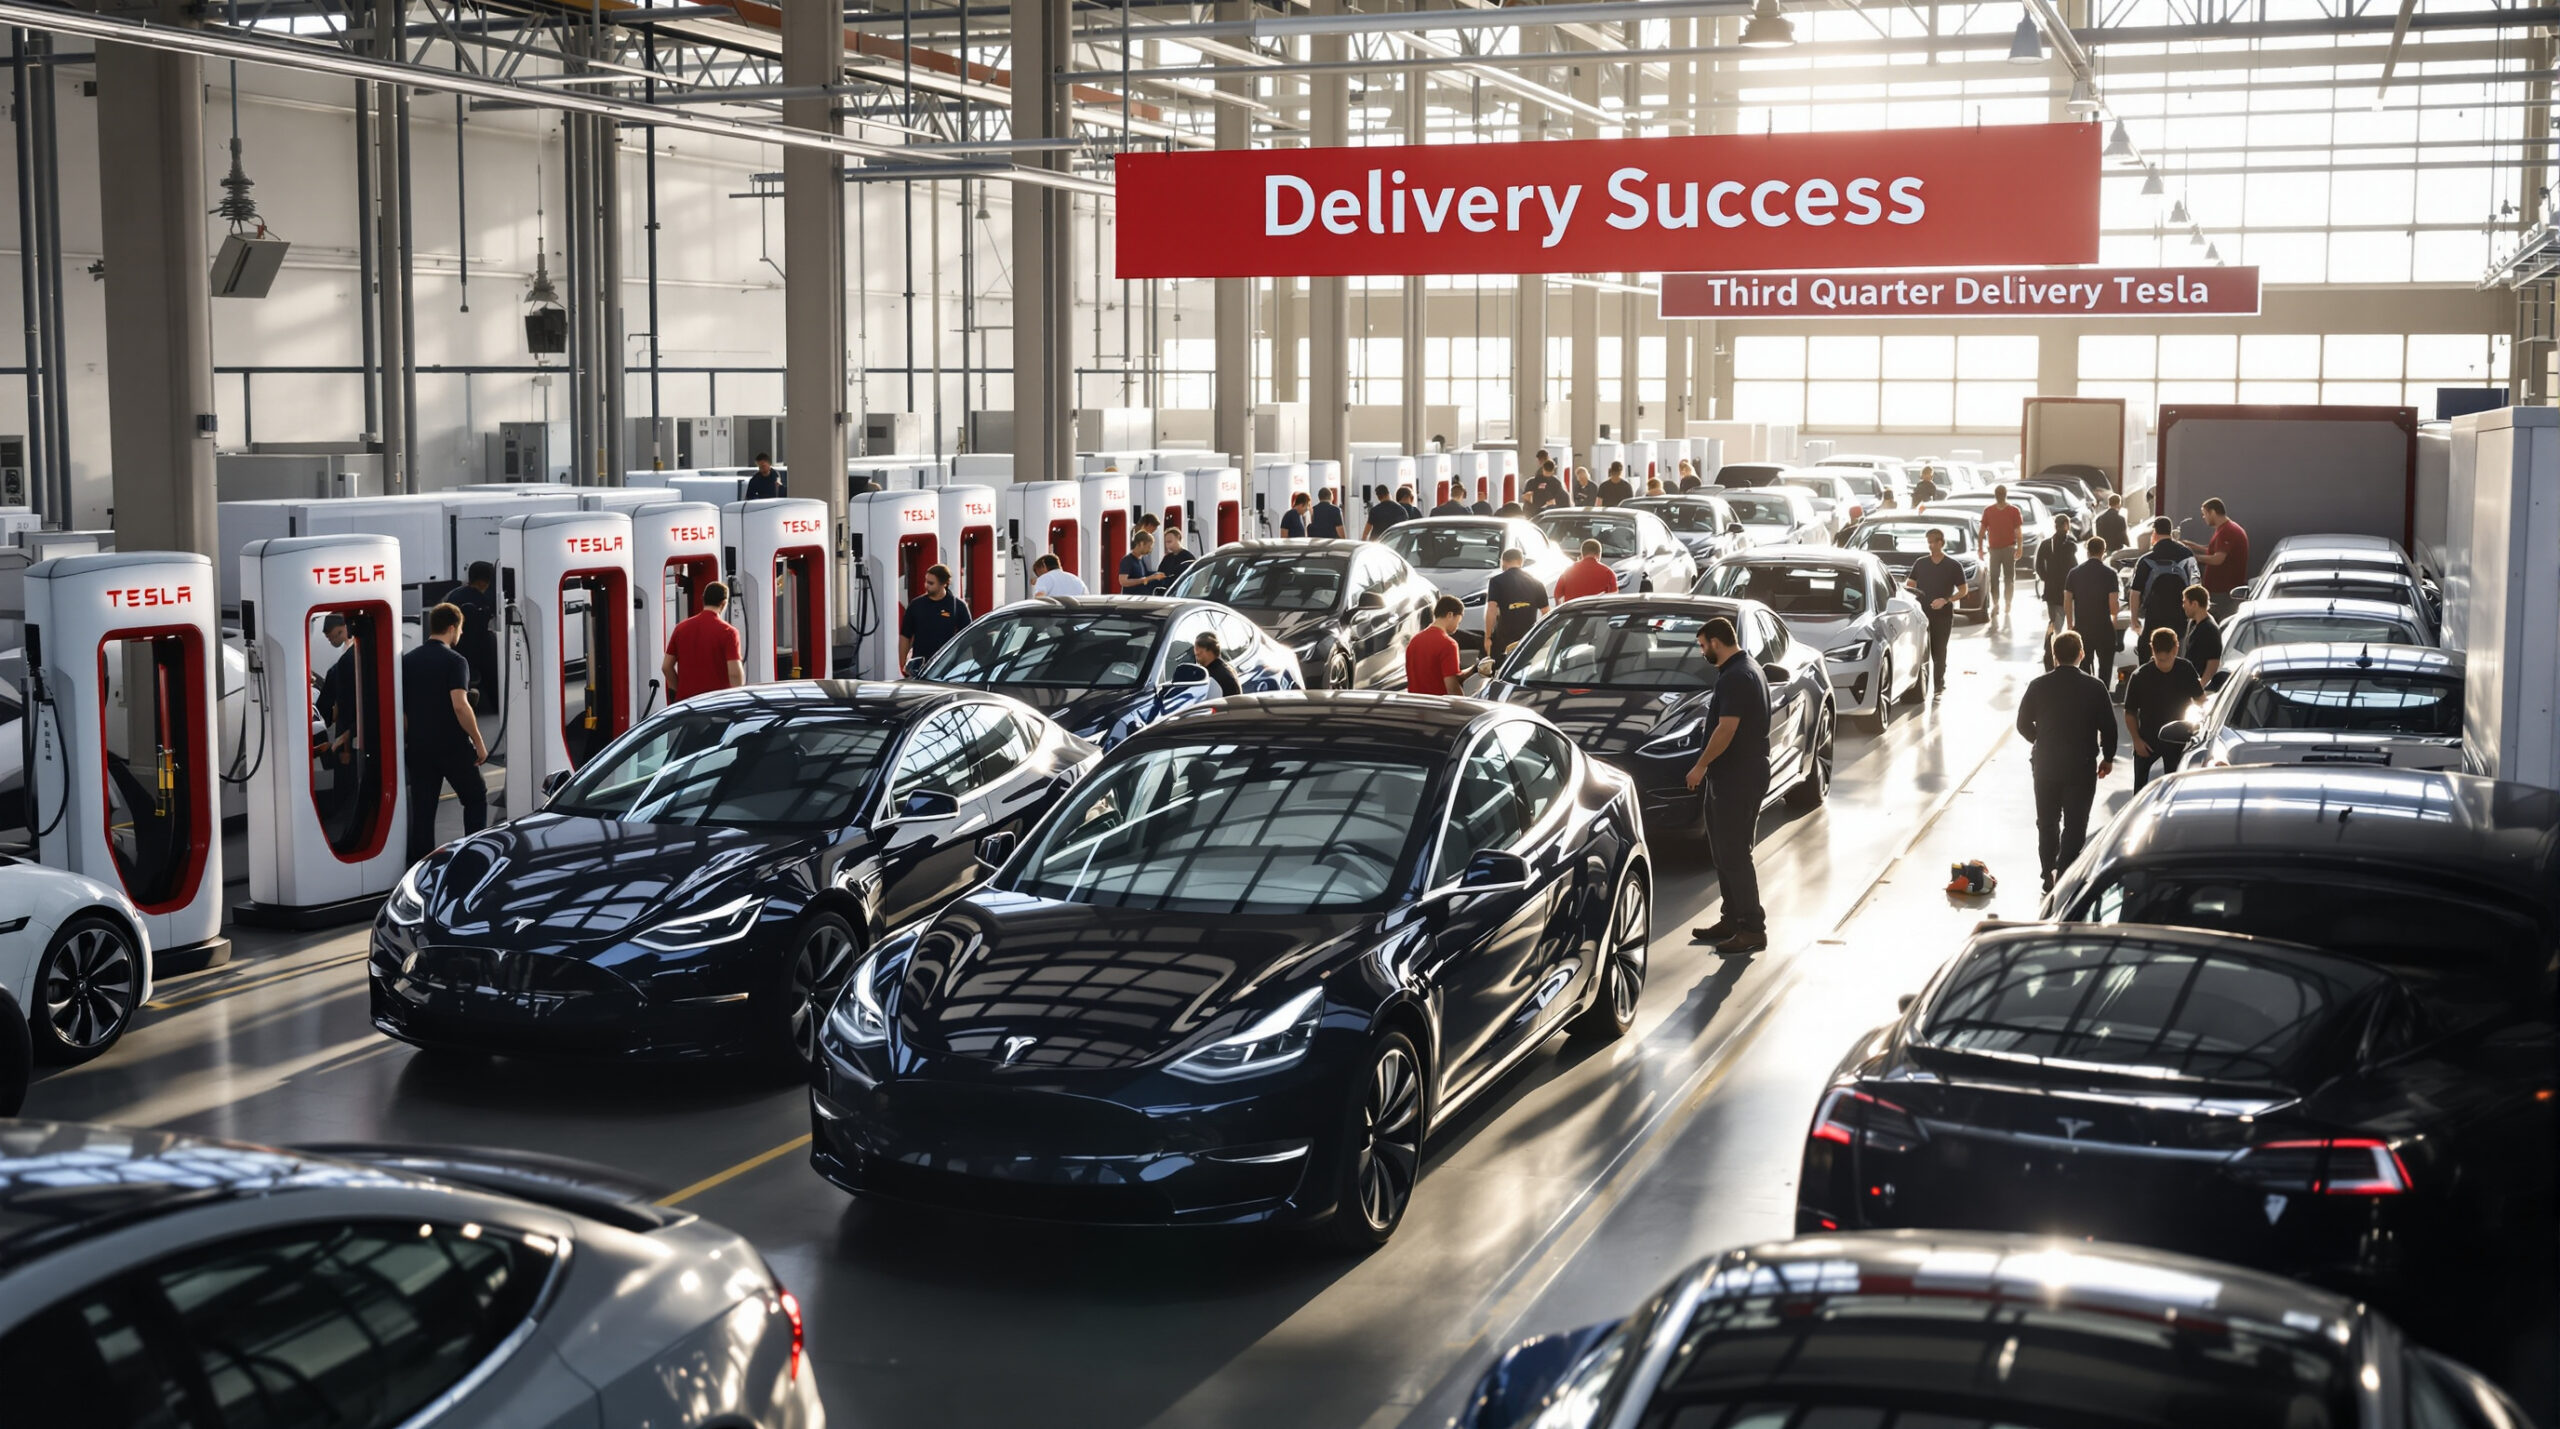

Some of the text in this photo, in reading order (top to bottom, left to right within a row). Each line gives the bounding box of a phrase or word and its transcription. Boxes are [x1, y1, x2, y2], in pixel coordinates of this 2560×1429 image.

[1266, 168, 1925, 248] Delivery Success
[1708, 275, 2208, 309] Third Quarter Delivery Tesla
[904, 509, 935, 522] TESLA
[671, 526, 715, 542] TESLA
[783, 519, 821, 534] TESLA
[567, 536, 623, 553] TESLA
[312, 564, 385, 585] TESLA
[106, 586, 191, 608] TESLA
